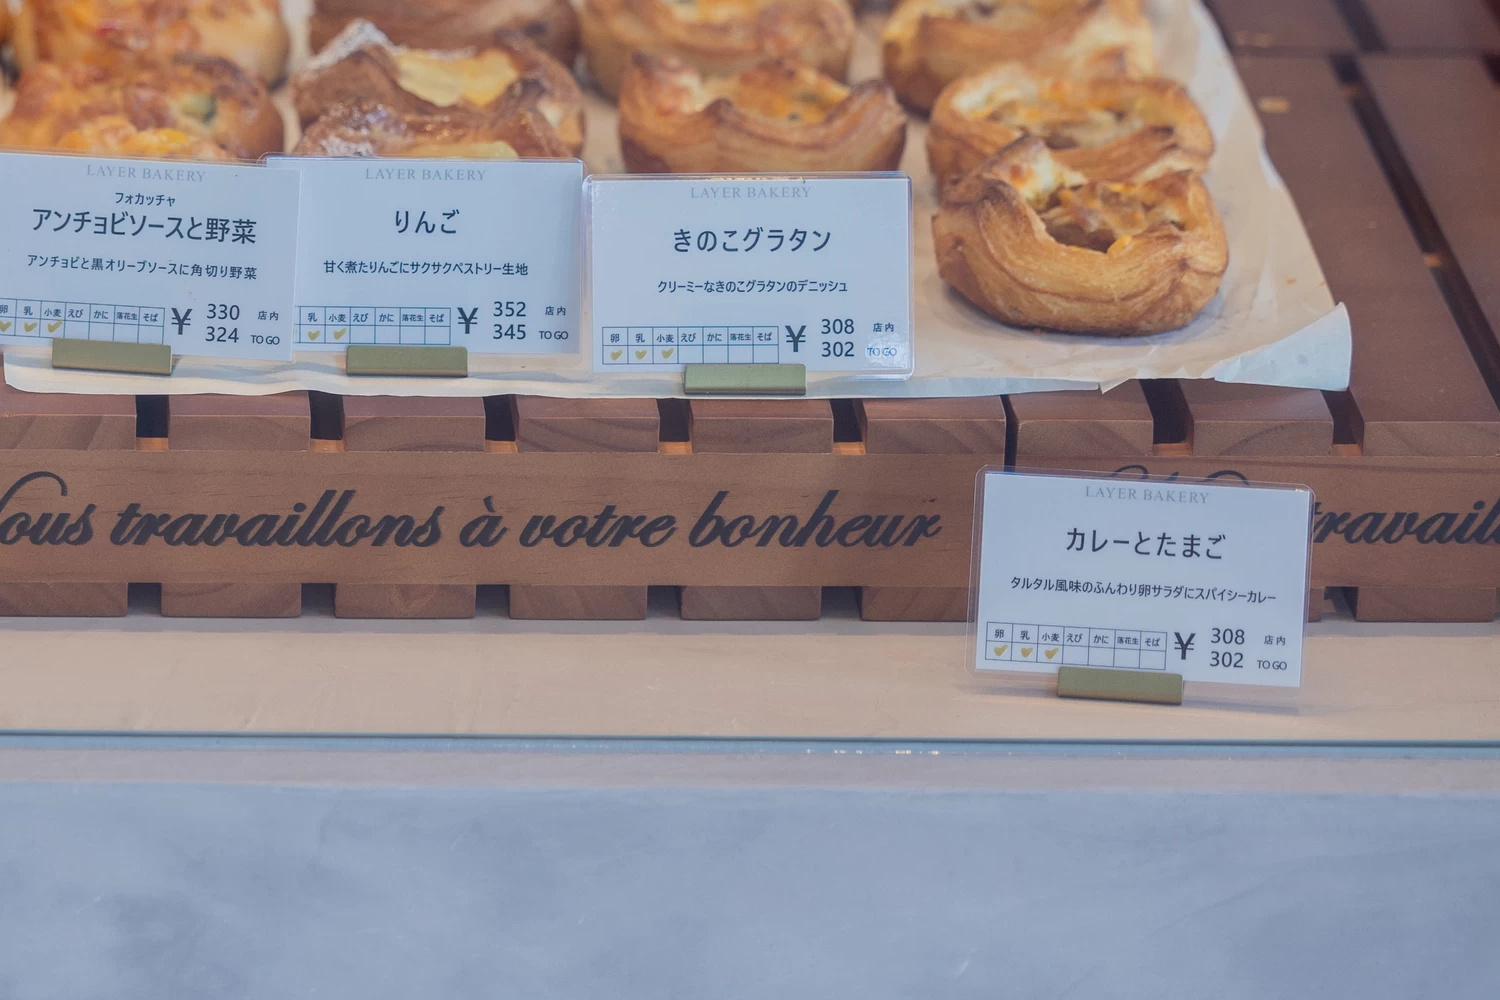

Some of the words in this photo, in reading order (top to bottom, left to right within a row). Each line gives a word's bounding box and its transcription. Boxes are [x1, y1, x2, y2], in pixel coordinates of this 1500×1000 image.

[86, 164, 136, 179] LAYER
[142, 167, 206, 183] BAKERY
[365, 168, 416, 181] LAYER
[422, 169, 486, 181] BAKERY
[115, 192, 176, 207] フォカッチャ
[691, 187, 741, 199] LAYER
[747, 187, 812, 199] BAKERY
[32, 207, 257, 244] アンチョビソースと野菜
[395, 208, 460, 235] りんご
[673, 226, 831, 252] きのこグラタン
[27, 254, 257, 280] アンチョビと黒オリーブソースに角切り野菜
[323, 259, 529, 276] 甘く煮たりんごにサクサクペストリー生地
[657, 280, 848, 294] クリーミーなきのこグラタンのデニッシュ
[206, 304, 240, 321] 330
[493, 301, 527, 318] 352
[493, 324, 527, 340] 345
[821, 318, 855, 335] 308
[205, 327, 240, 344] 324
[821, 341, 855, 357] 302
[1085, 486, 1137, 500] LAYER
[1143, 489, 1210, 504] BAKERY
[110, 489, 445, 548] travaillons
[460, 496, 510, 547] à
[519, 504, 676, 548] votre
[688, 490, 943, 548] bonheur
[1066, 527, 1226, 560] カレーとたまご
[1010, 576, 1277, 603] タルタル風味のふんわり卵サラダにスパイシーカレー
[1210, 628, 1245, 645] 308
[1209, 651, 1244, 669] 302
